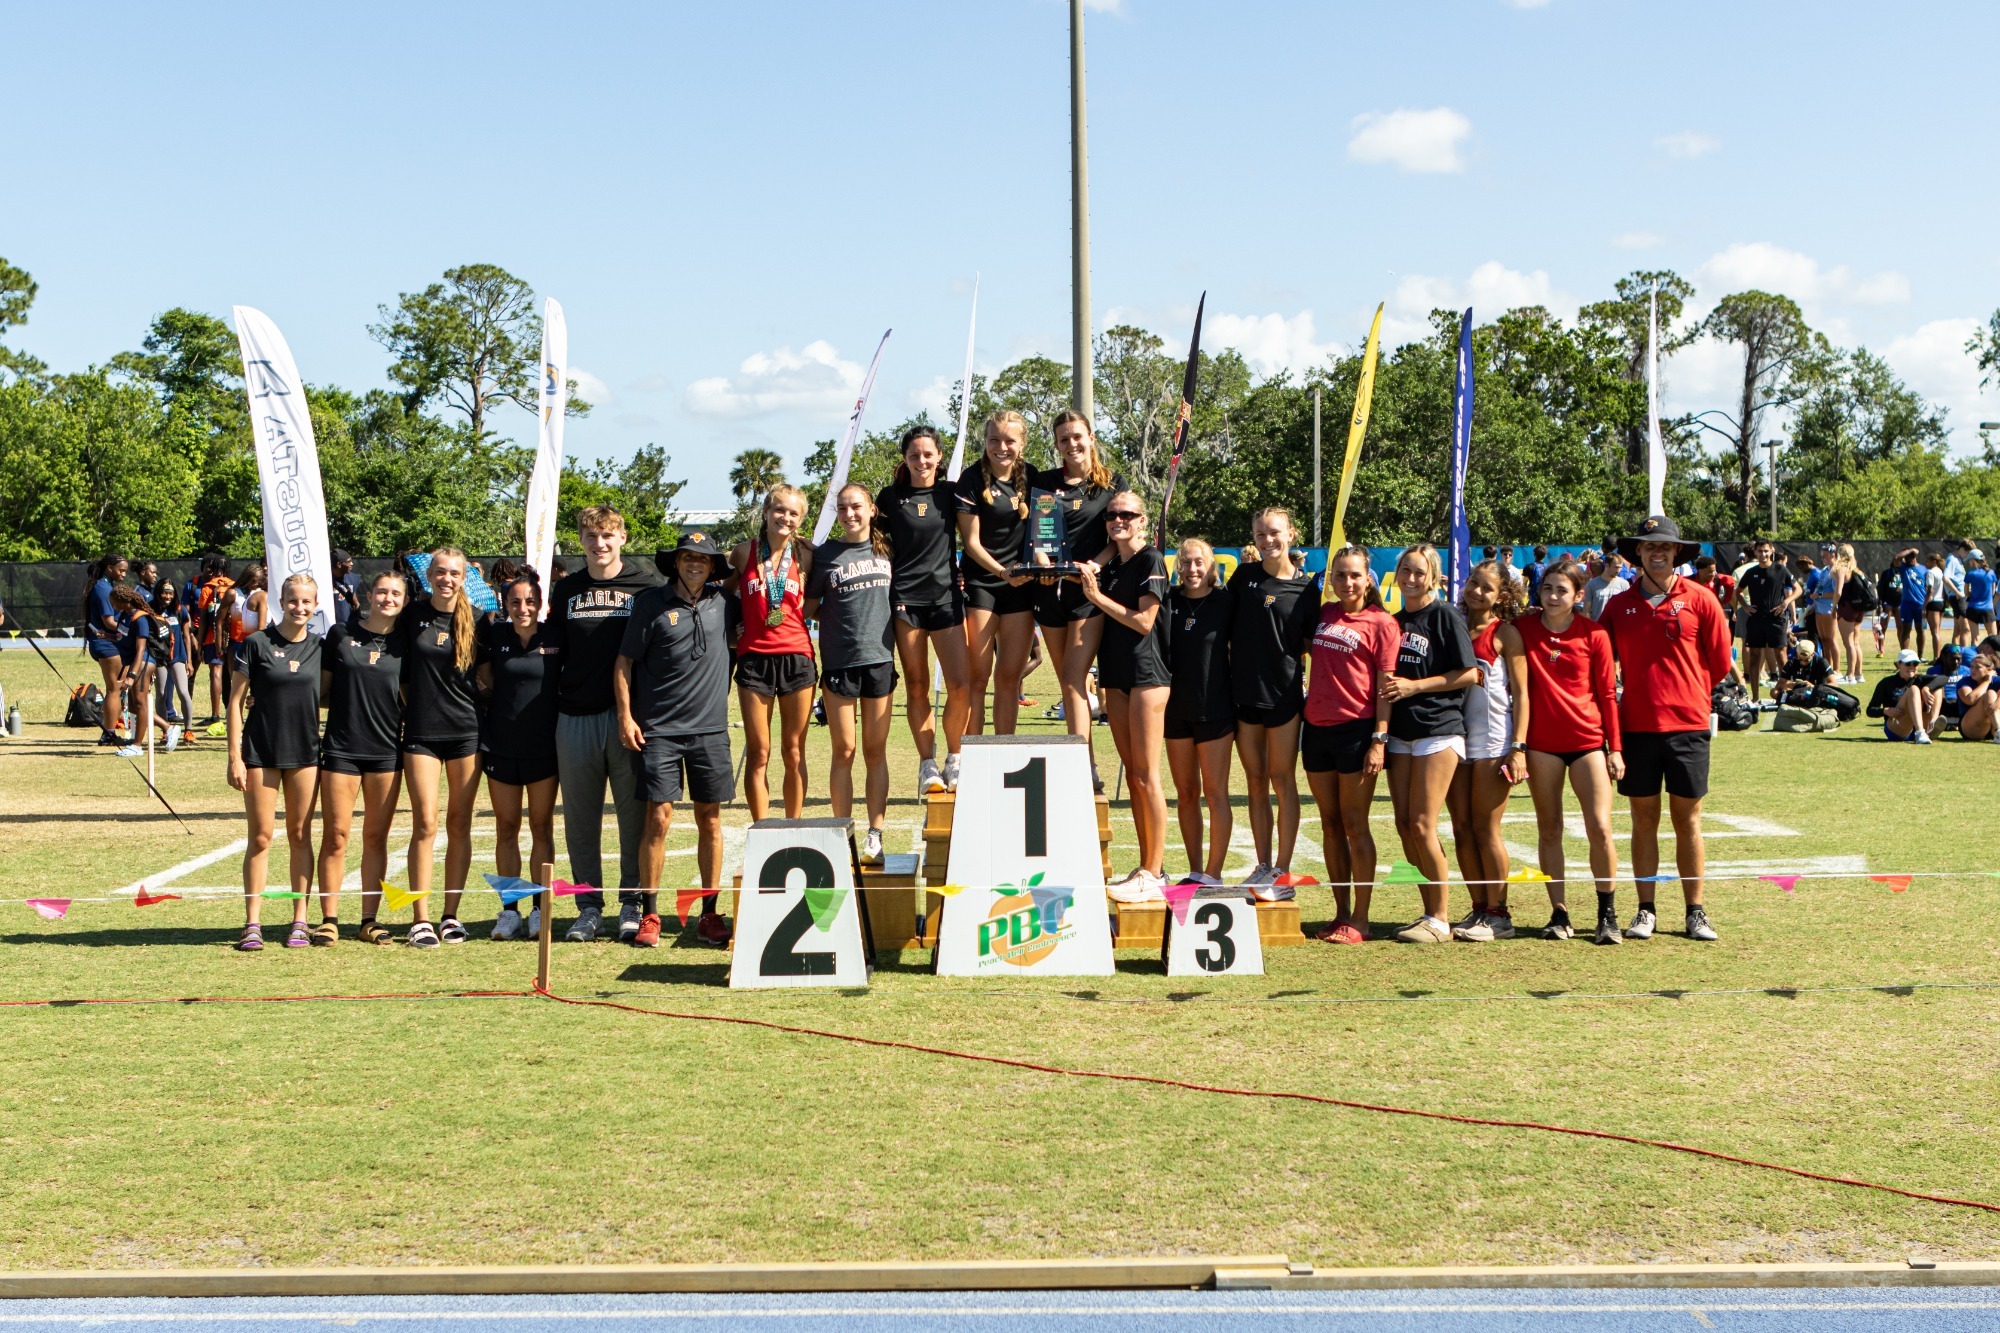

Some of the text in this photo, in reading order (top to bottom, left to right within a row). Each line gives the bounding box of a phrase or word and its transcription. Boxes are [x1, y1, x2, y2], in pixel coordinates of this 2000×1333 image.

[918, 503, 928, 517] F
[830, 559, 892, 589] FLAGLER
[838, 582, 865, 594] TRACK
[567, 590, 635, 614] FLAGLER
[1264, 594, 1276, 608] F
[669, 611, 679, 626] F
[1185, 618, 1196, 631] F
[437, 632, 449, 645] F
[1324, 640, 1354, 654] COUNTRY
[369, 651, 381, 665] F
[1399, 654, 1421, 664] FIELD
[289, 660, 300, 673] F
[1003, 756, 1047, 857] 1
[758, 846, 837, 977] 2
[977, 895, 1075, 957] PBC
[1194, 902, 1236, 973] 3
